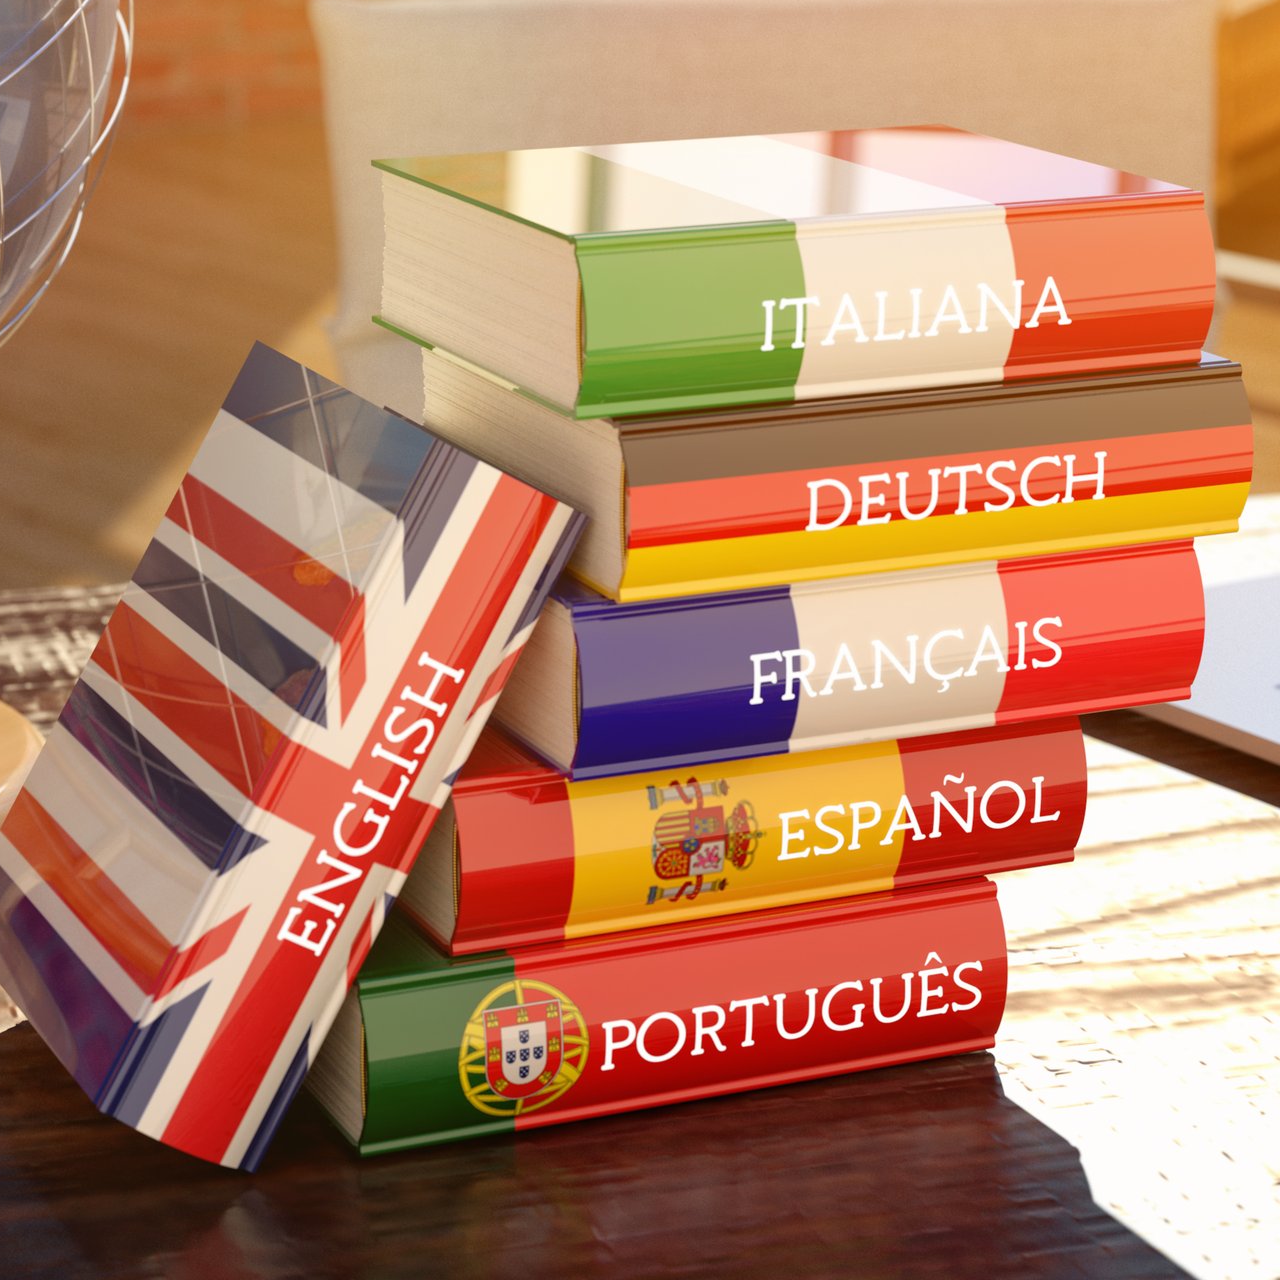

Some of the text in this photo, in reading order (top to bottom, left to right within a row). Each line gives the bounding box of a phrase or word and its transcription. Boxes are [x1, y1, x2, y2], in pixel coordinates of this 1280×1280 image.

[760, 276, 1072, 351] ITALIANA
[805, 451, 1107, 531] DEUTSCH
[748, 616, 1063, 705] FRANÇAIS
[276, 651, 466, 957] ENGLISH
[777, 772, 1060, 861] ESPAÑOL
[600, 952, 983, 1071] PORTUGUÊS
